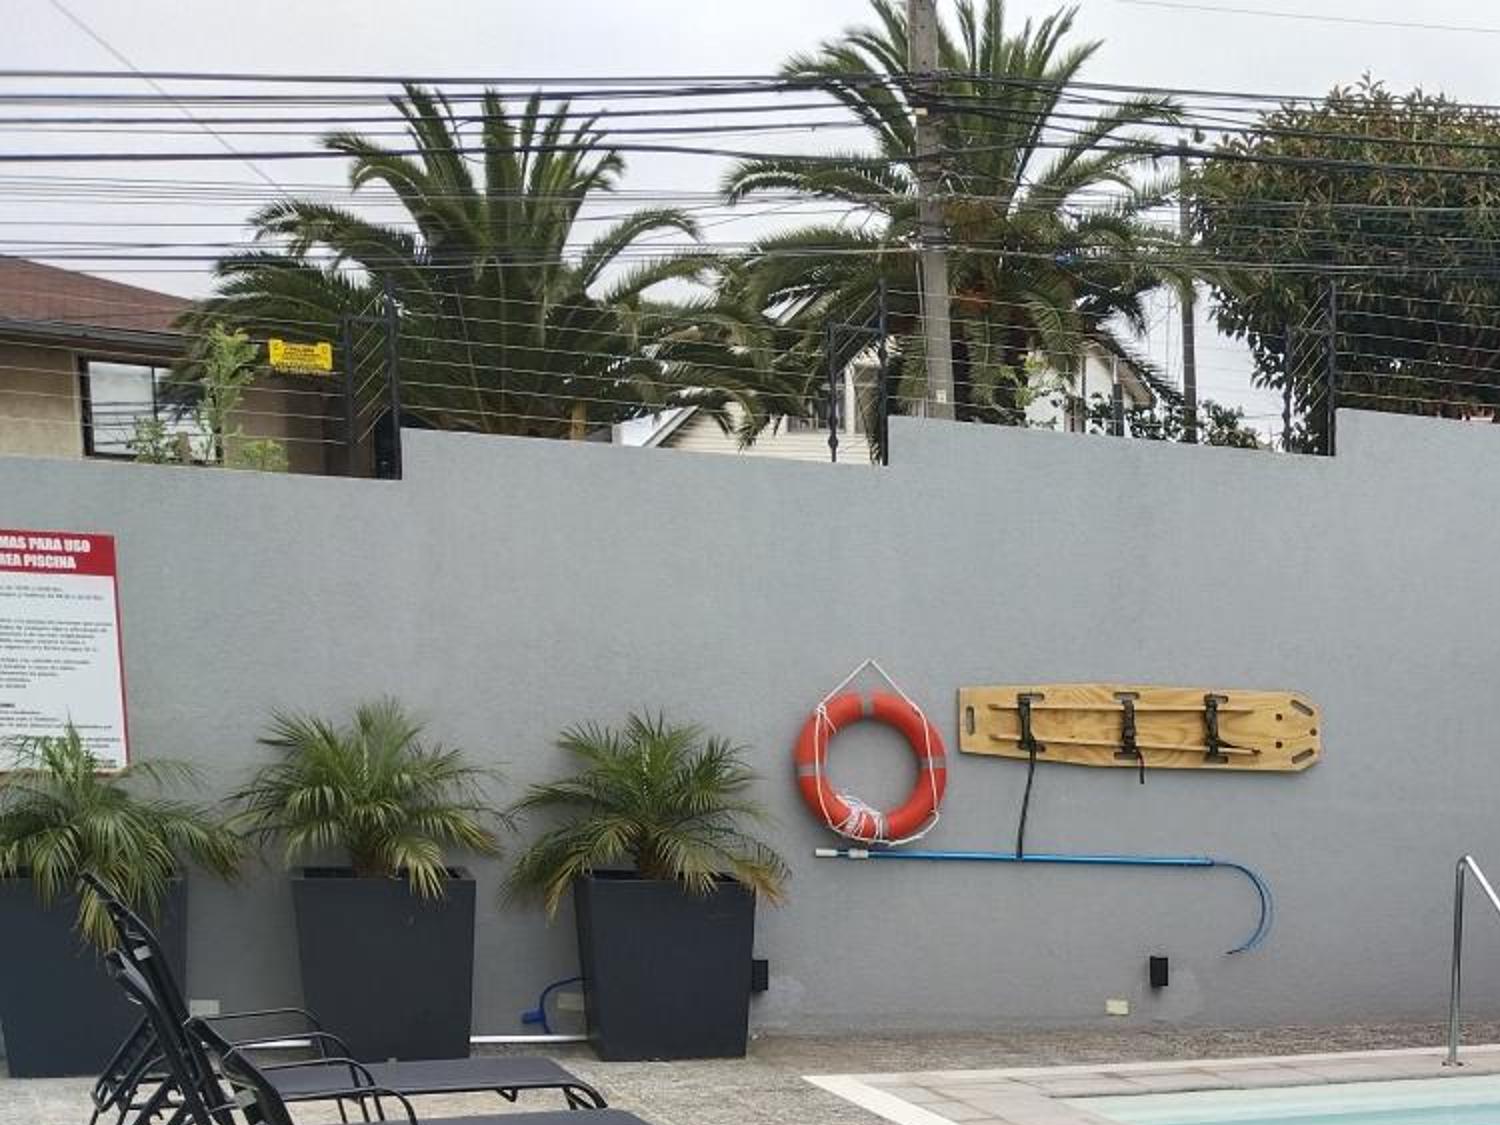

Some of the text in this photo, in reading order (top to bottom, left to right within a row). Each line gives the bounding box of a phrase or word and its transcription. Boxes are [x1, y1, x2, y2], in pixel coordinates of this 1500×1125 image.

[28, 537, 63, 551] PARA
[63, 539, 91, 553] USO
[23, 554, 77, 569] PISCINA
